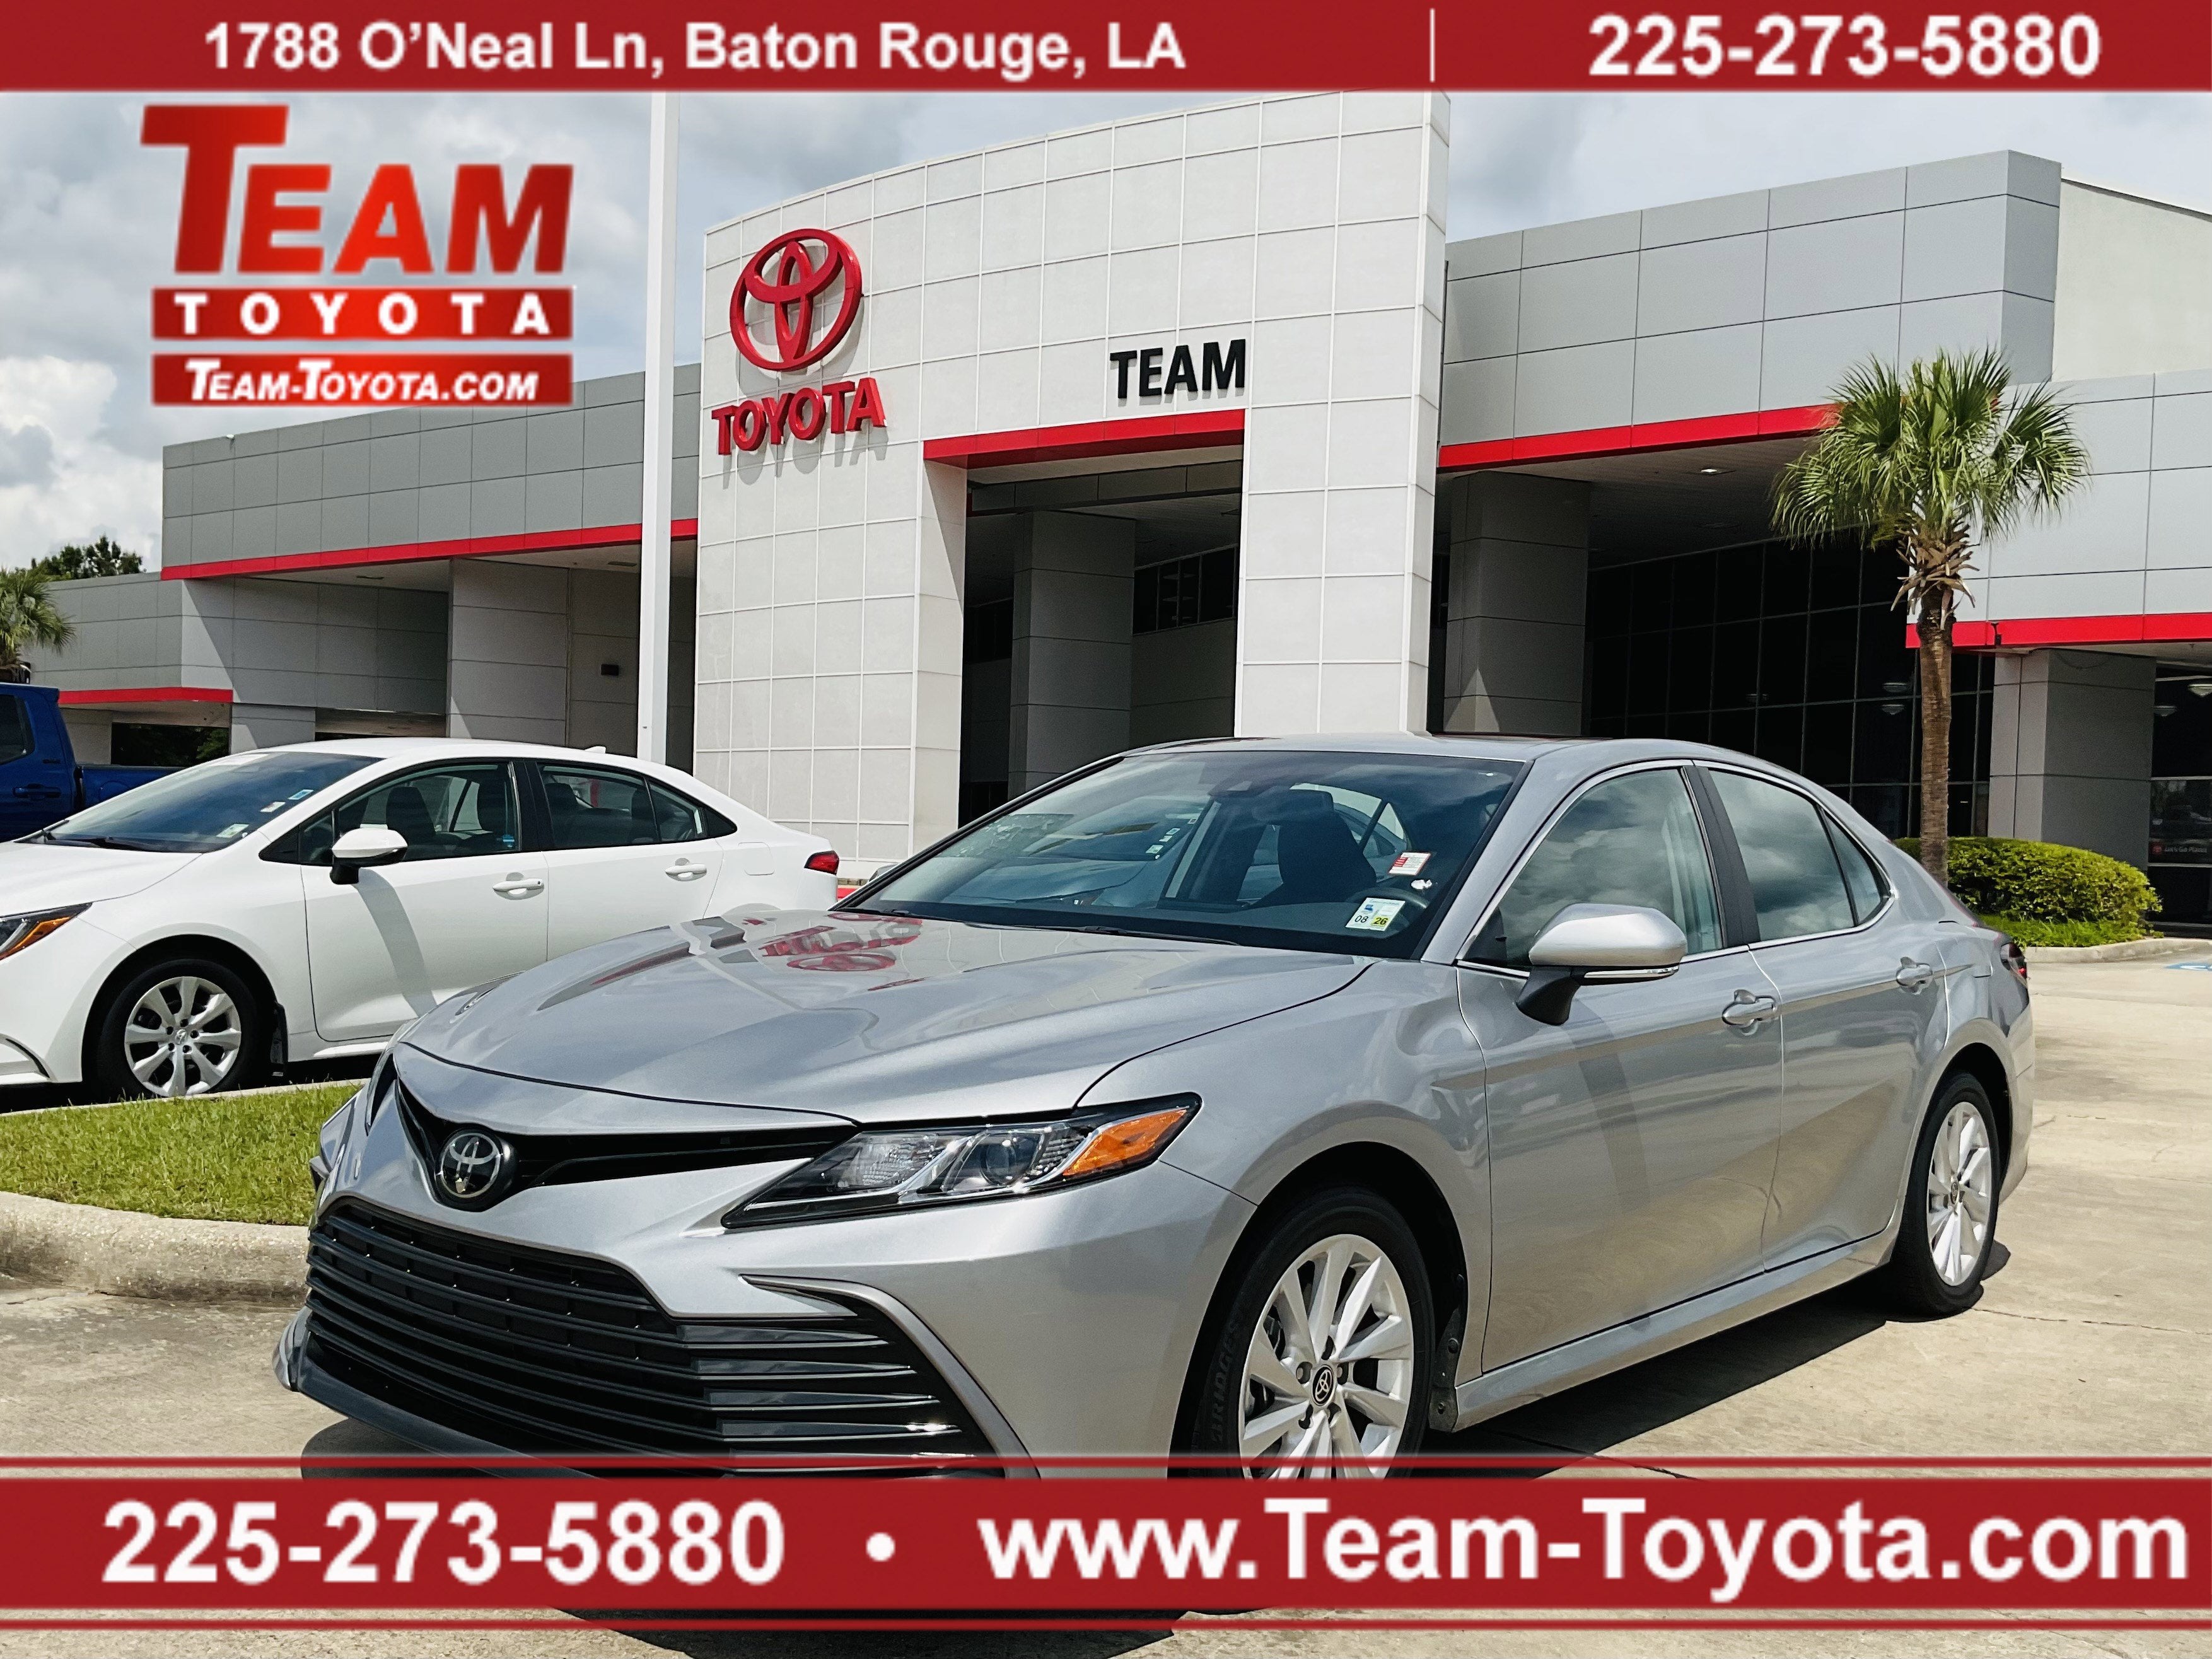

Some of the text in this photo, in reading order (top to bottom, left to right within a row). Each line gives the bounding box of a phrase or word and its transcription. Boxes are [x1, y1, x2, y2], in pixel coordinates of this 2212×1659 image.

[1110, 339, 1246, 399] TEAM
[711, 376, 887, 456] TOYOTA
[1354, 915, 1388, 925] 08 26
